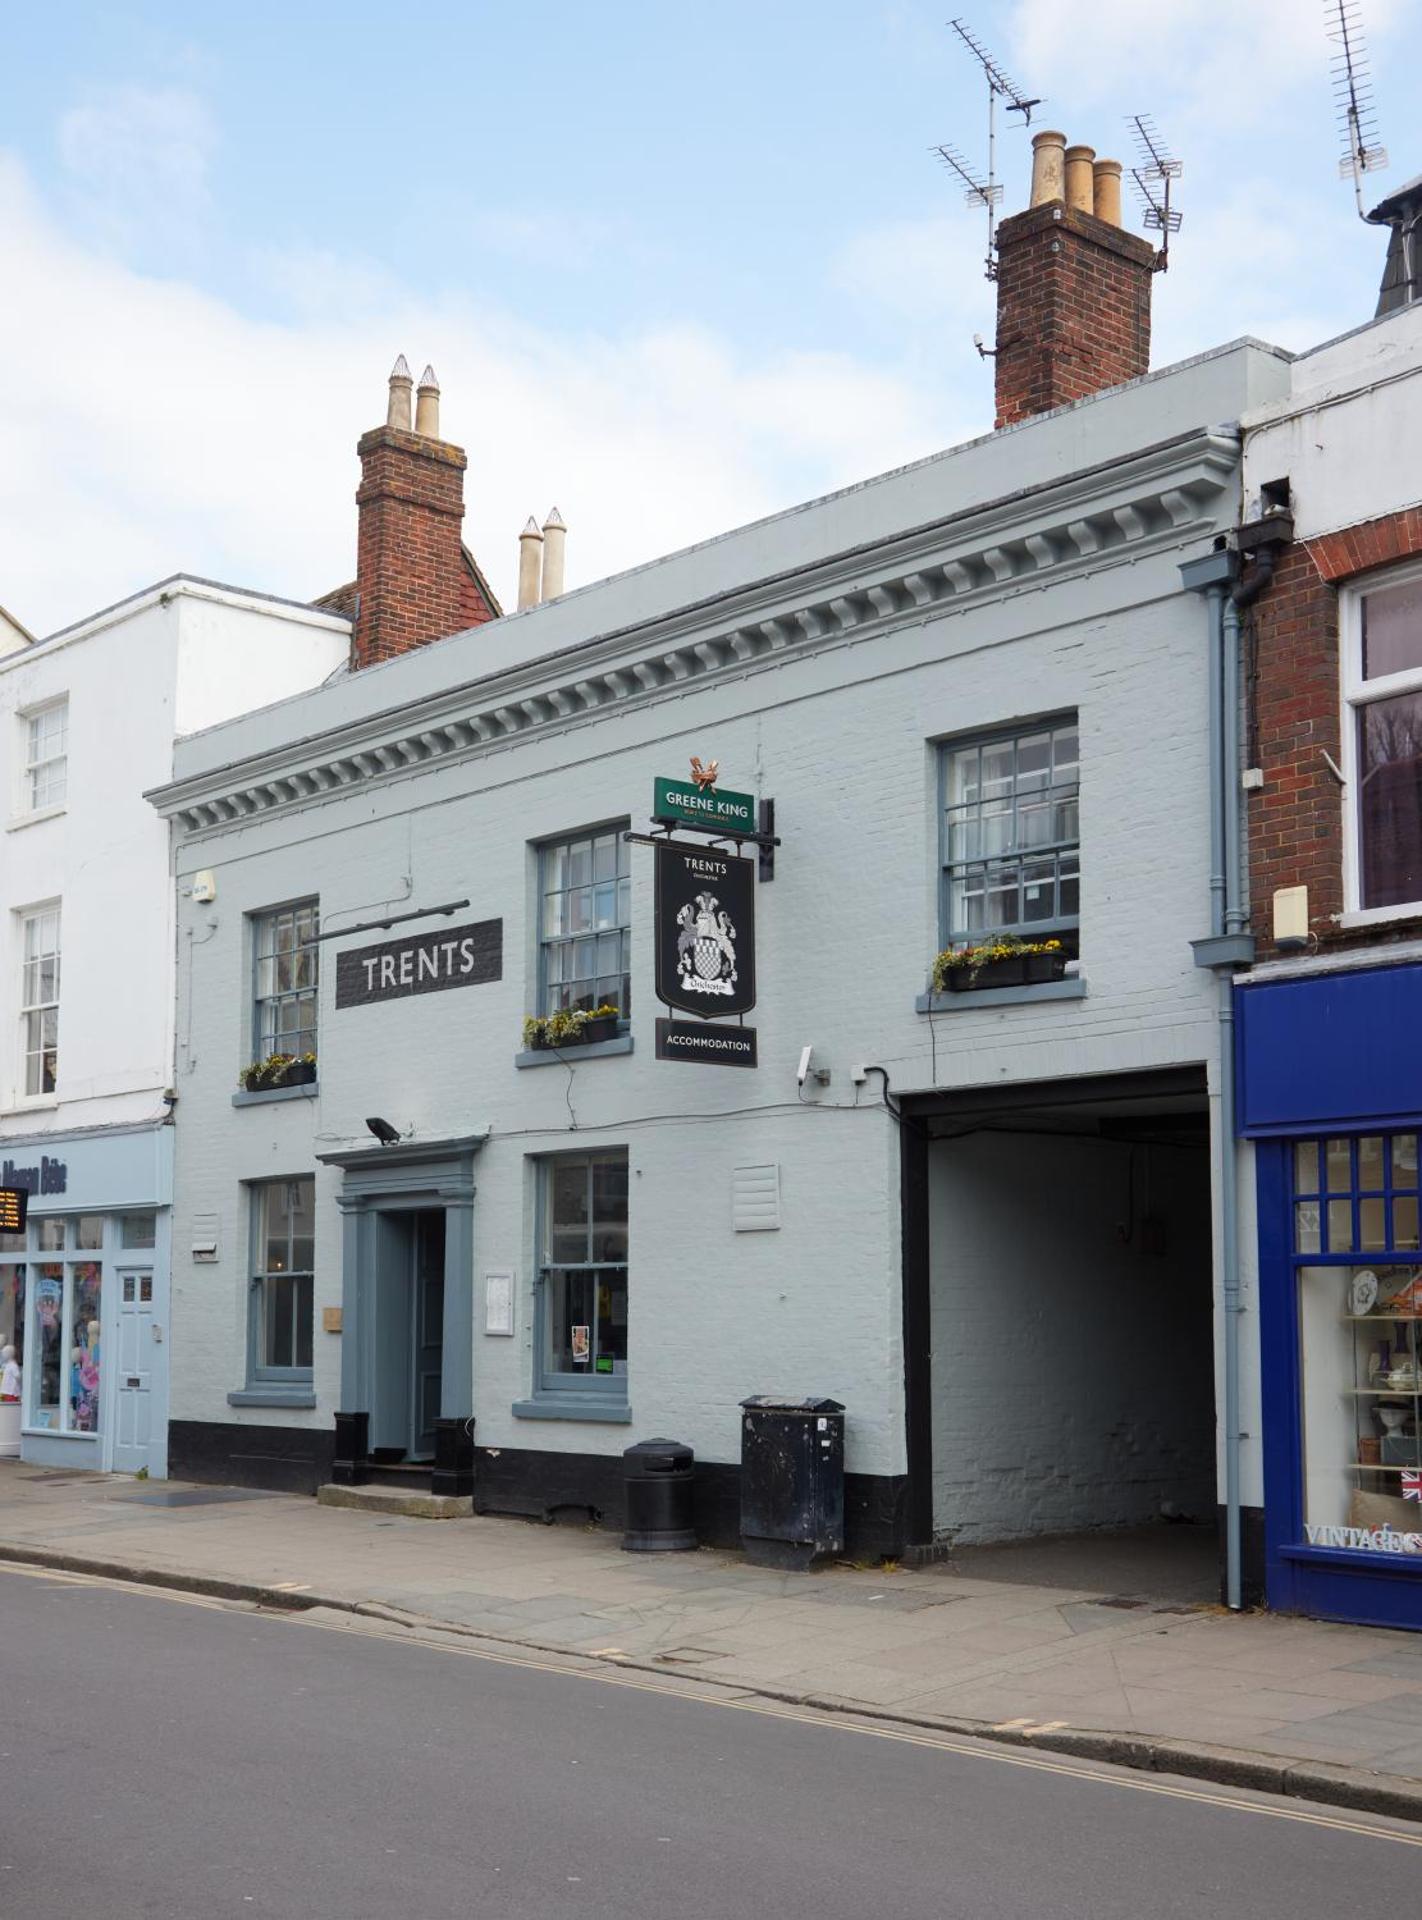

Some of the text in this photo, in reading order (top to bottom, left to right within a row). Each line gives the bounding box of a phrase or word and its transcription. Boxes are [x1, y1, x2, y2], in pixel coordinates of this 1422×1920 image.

[666, 791, 714, 812] GREENE
[717, 801, 748, 818] KING
[684, 857, 727, 874] TRENTS
[362, 938, 474, 990] TRENTS
[666, 1035, 751, 1051] ACCOMMODATION
